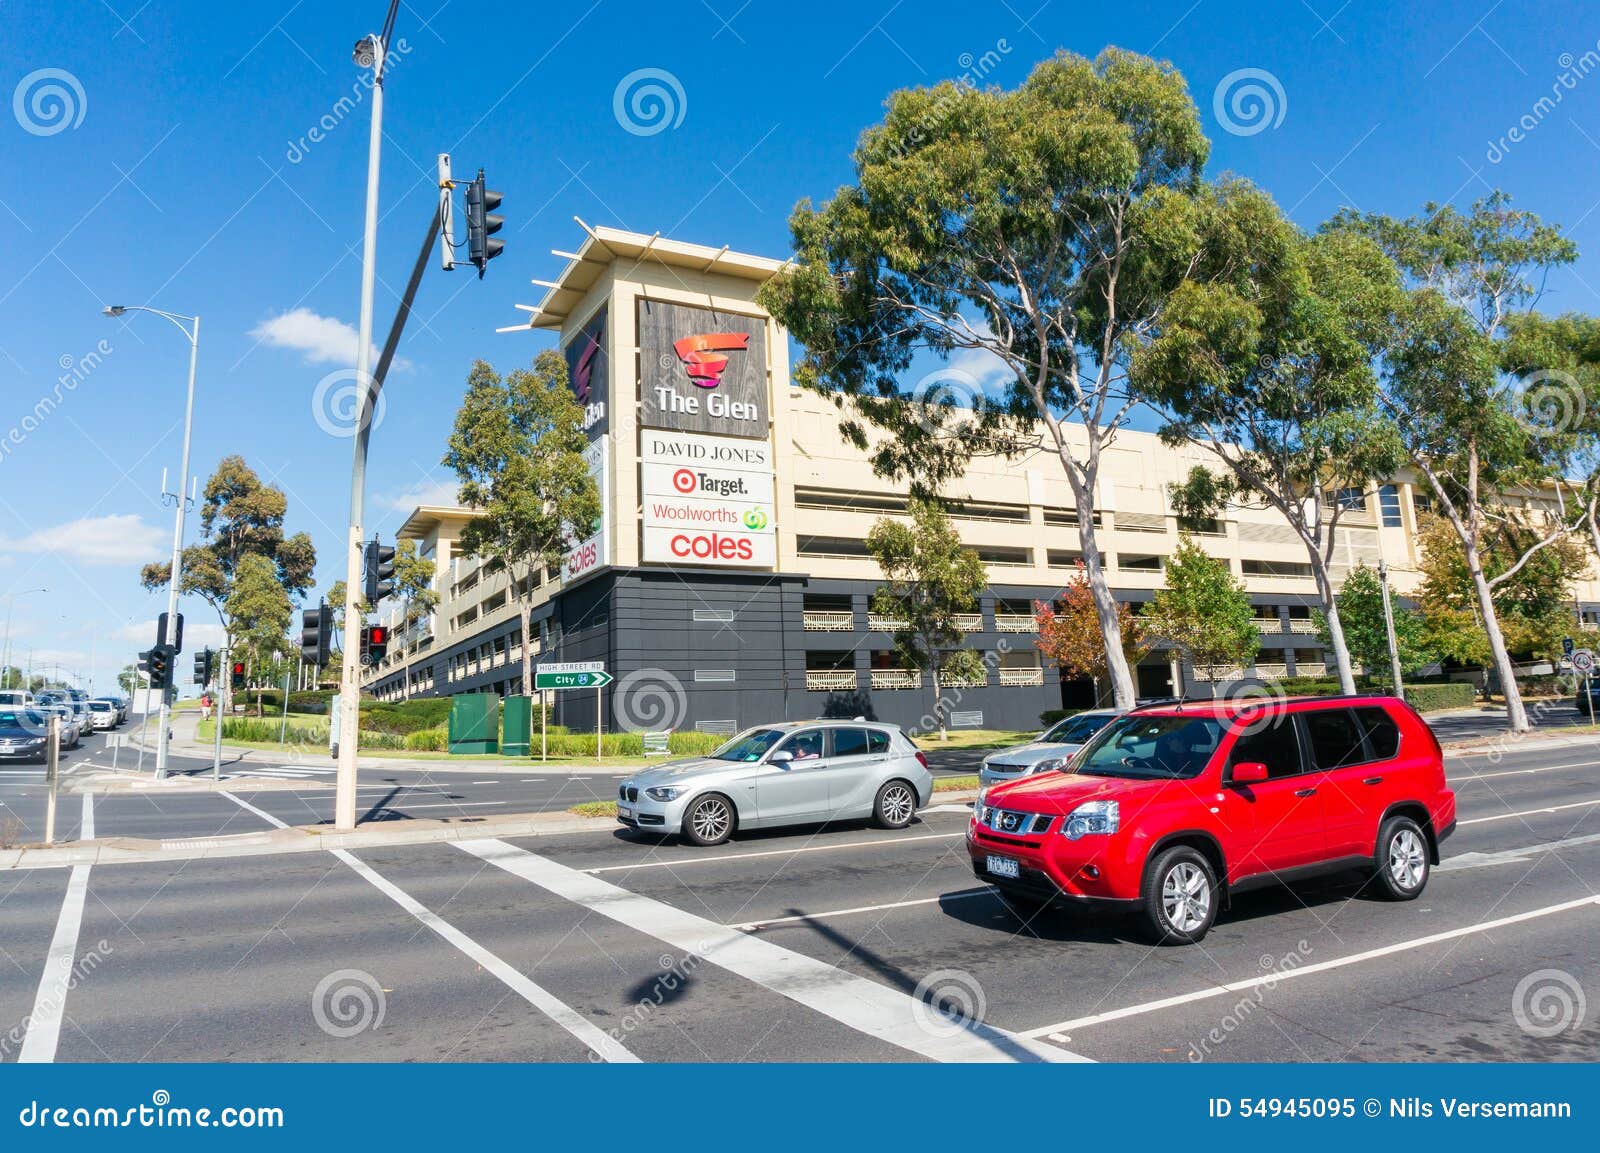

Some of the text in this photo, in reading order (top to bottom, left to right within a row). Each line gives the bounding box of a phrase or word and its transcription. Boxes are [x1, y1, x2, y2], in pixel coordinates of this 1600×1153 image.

[654, 387, 758, 421] The Glen
[653, 441, 765, 464] DAVID JONES
[697, 473, 748, 496] Target.
[653, 504, 738, 523] Woolworths
[671, 533, 753, 560] coles
[568, 543, 597, 574] coles
[555, 676, 575, 685] City
